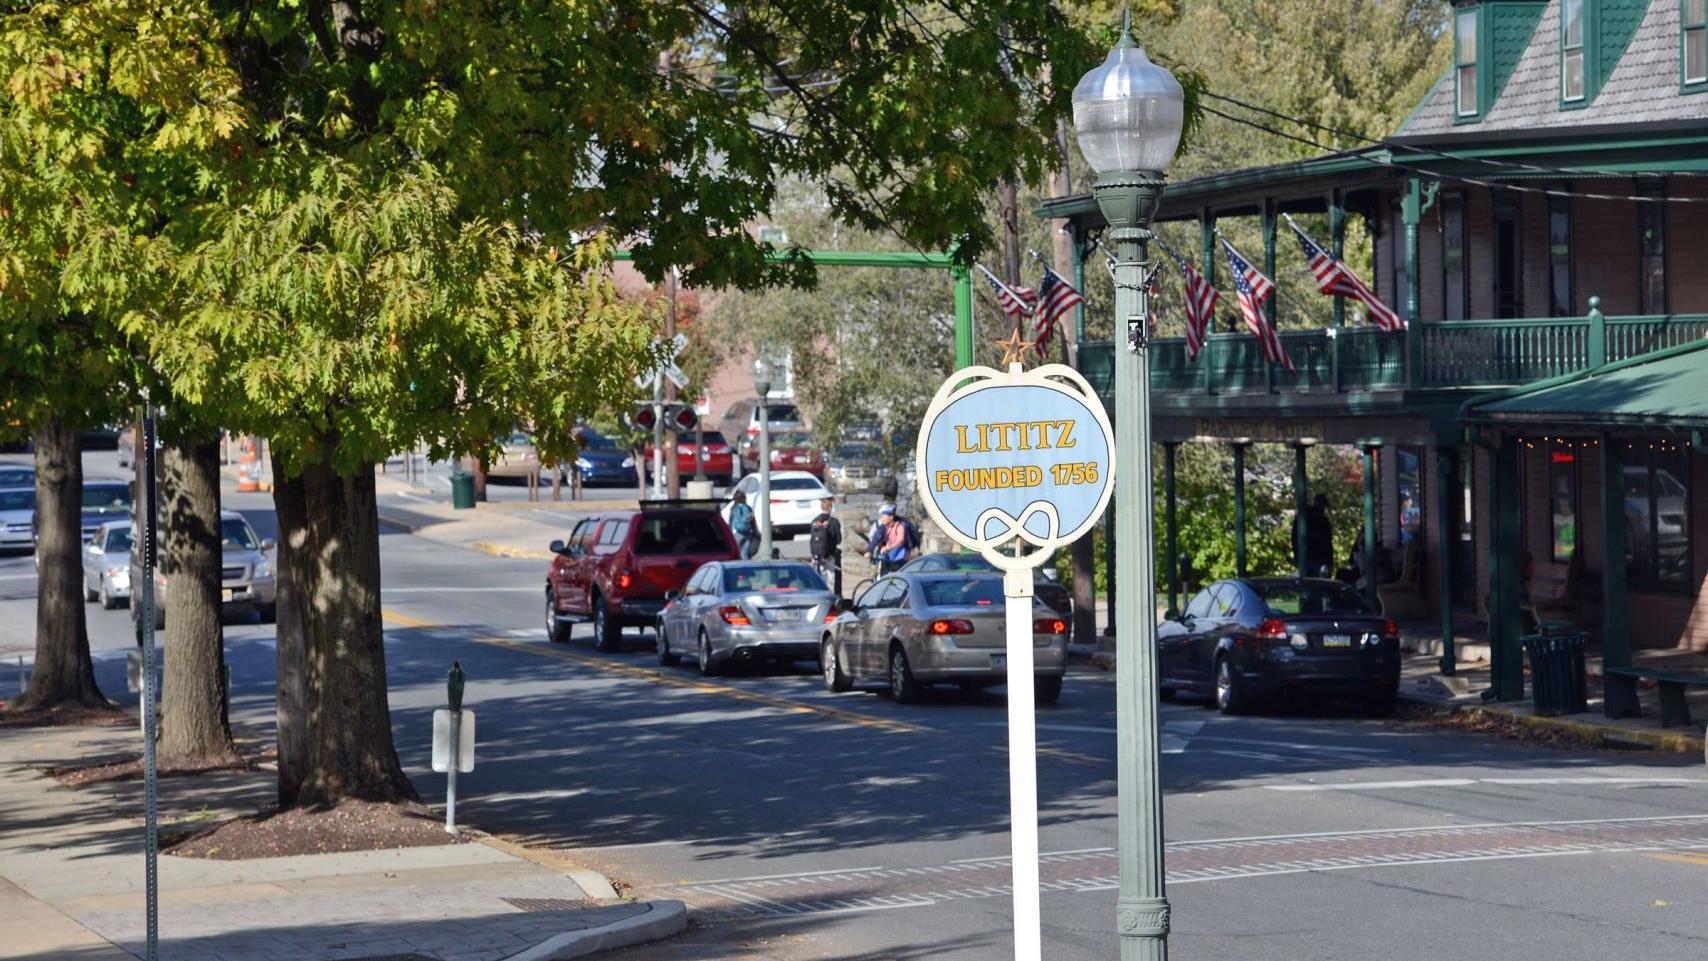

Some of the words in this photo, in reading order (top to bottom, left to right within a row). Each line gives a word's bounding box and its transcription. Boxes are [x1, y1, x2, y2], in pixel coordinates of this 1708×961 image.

[954, 419, 1077, 453] LITITZ
[935, 465, 1043, 492] FOUNDED
[1049, 462, 1099, 486] 1756
